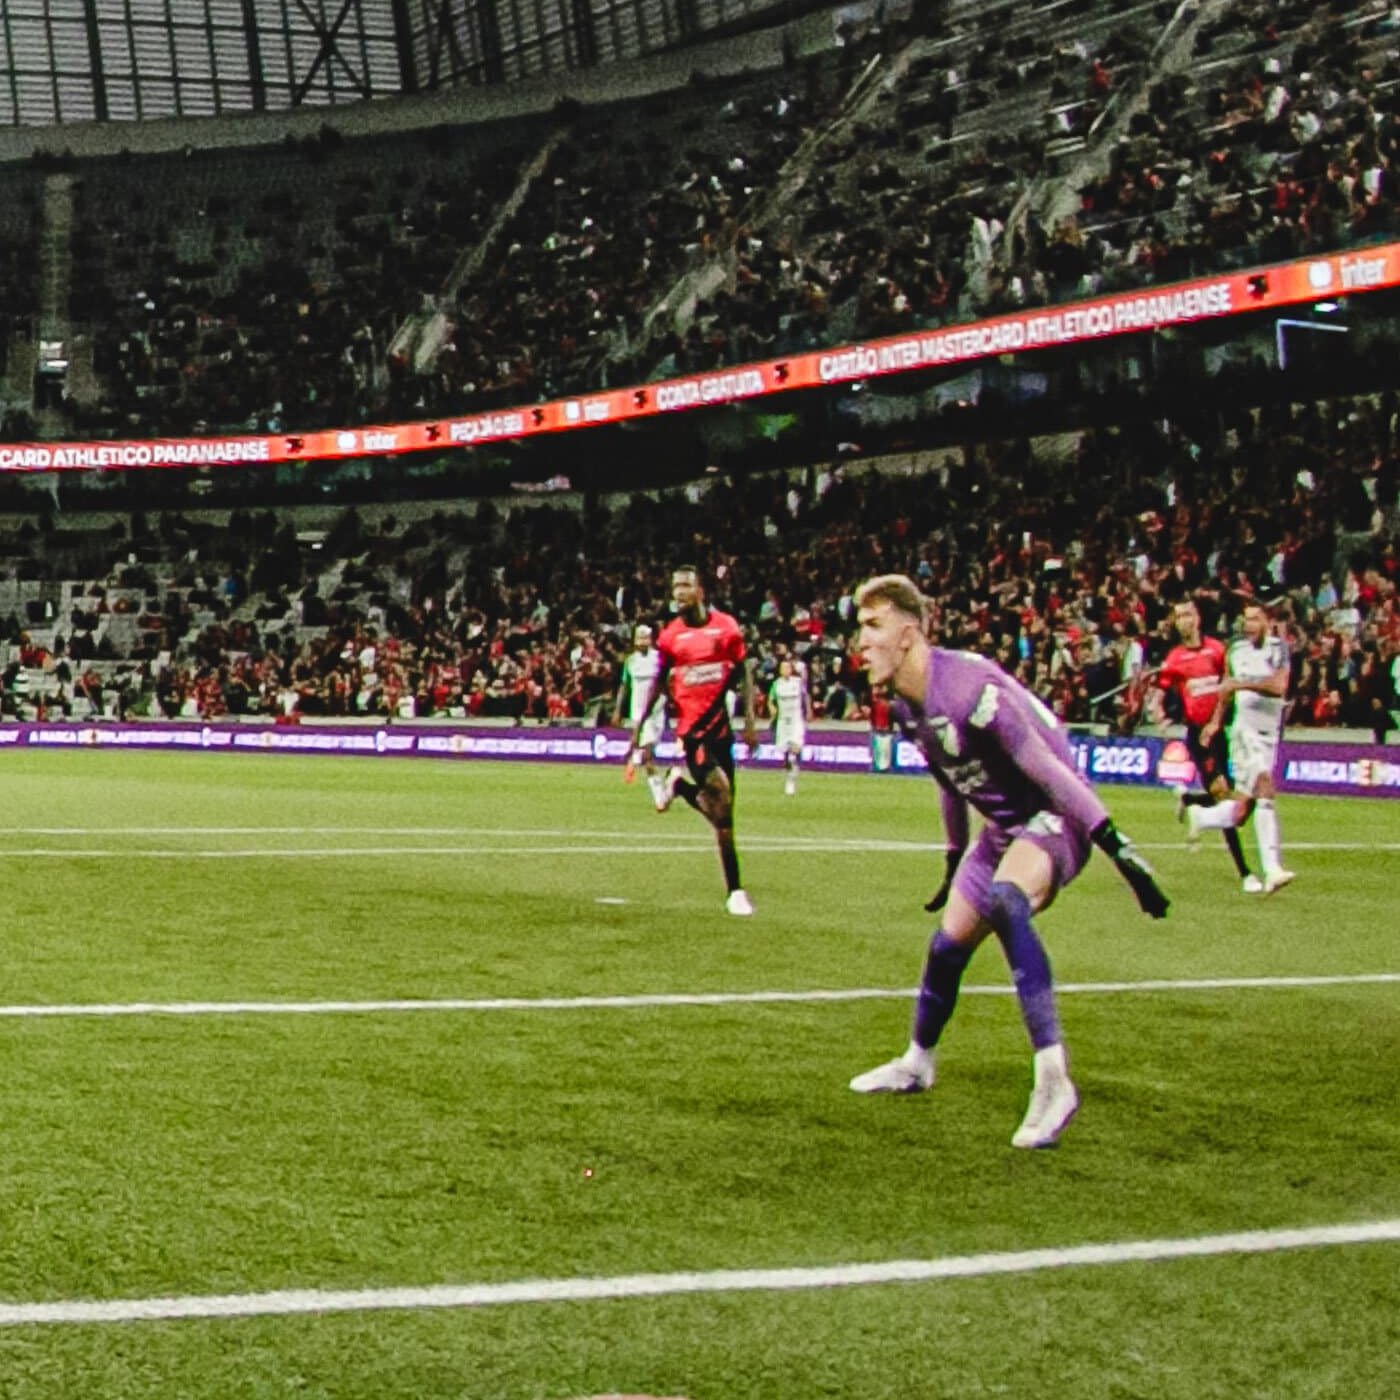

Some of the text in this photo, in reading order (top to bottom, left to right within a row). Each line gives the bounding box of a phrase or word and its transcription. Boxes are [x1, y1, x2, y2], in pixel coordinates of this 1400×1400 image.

[1339, 257, 1388, 287] inter
[819, 282, 1232, 382] CARTÃO INTER MASTERCARD ATHLETICO PARANAENSE
[52, 445, 152, 467] ATHLETICO
[153, 440, 270, 464] PARANAENSE
[362, 430, 397, 452] inter
[1091, 745, 1150, 776] 2023
